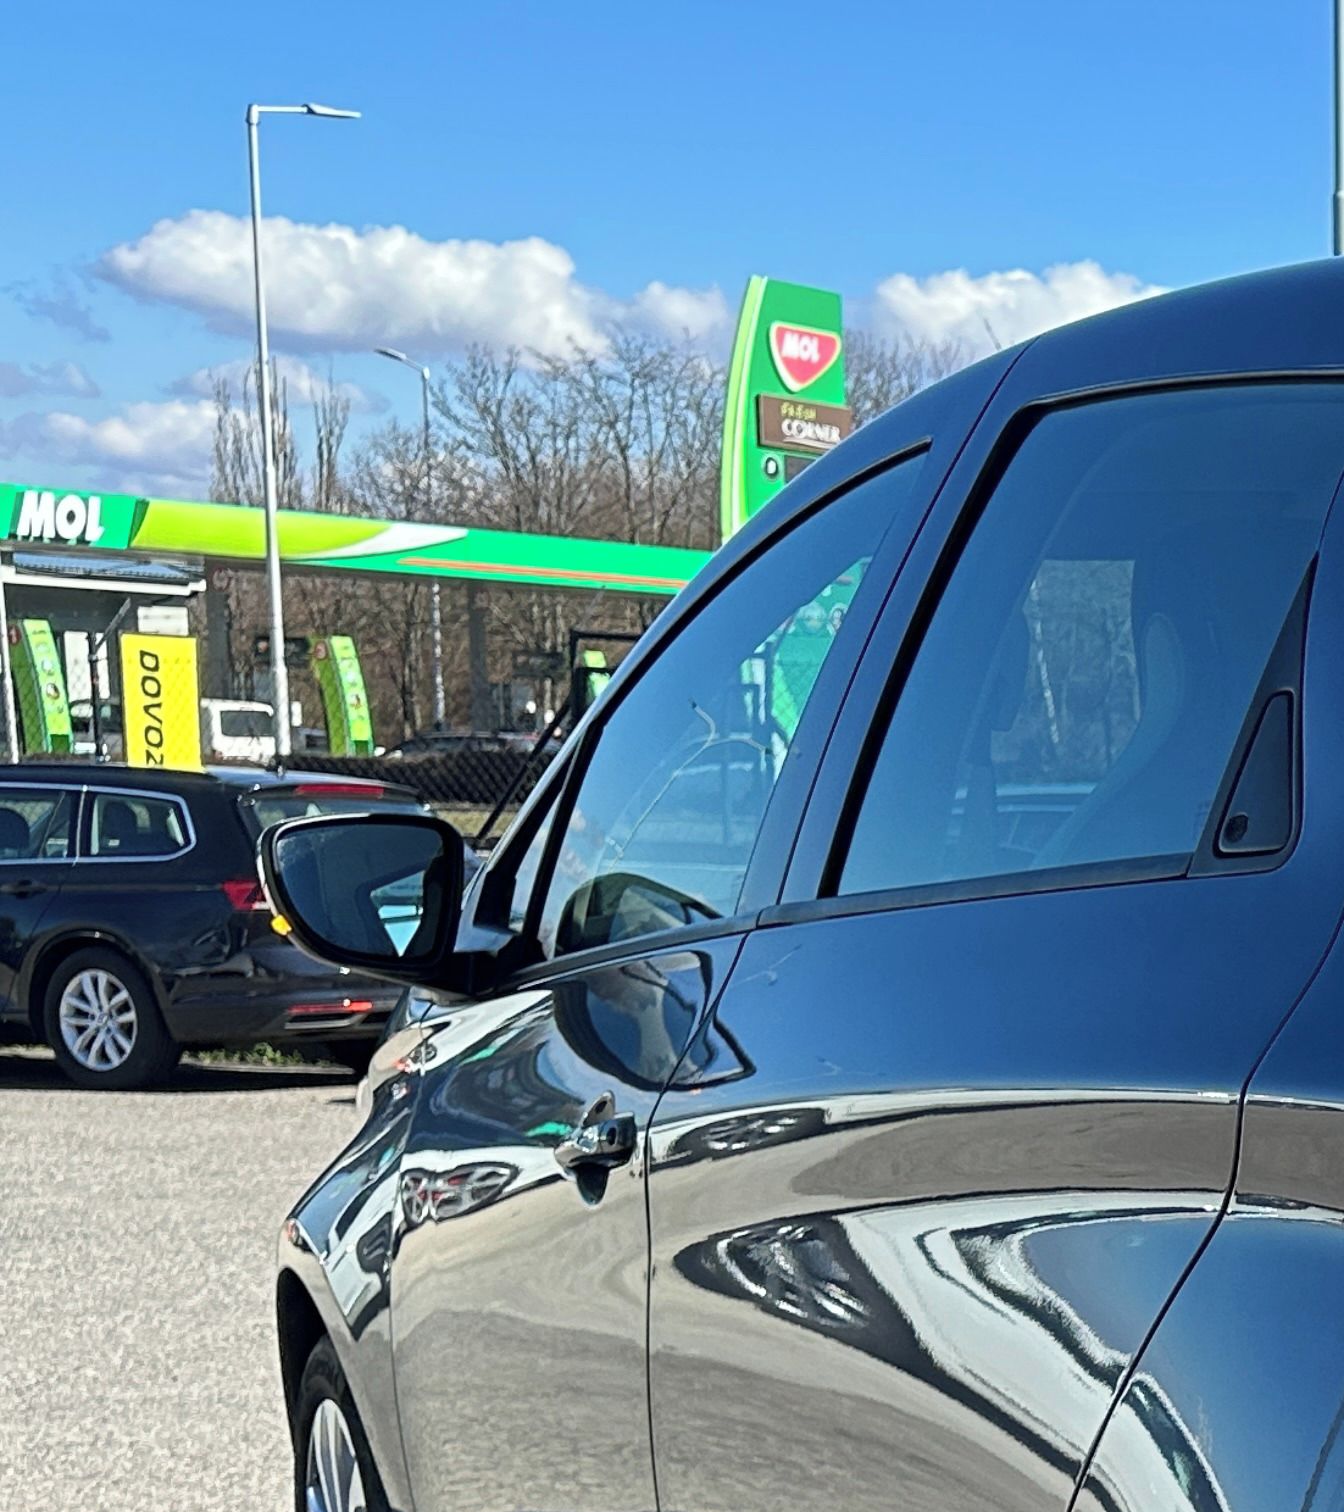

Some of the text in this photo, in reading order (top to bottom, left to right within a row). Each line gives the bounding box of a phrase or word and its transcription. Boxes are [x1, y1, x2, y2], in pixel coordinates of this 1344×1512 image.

[782, 331, 820, 364] MOL
[17, 489, 104, 541] MOL
[139, 650, 164, 765] DOVOZ
